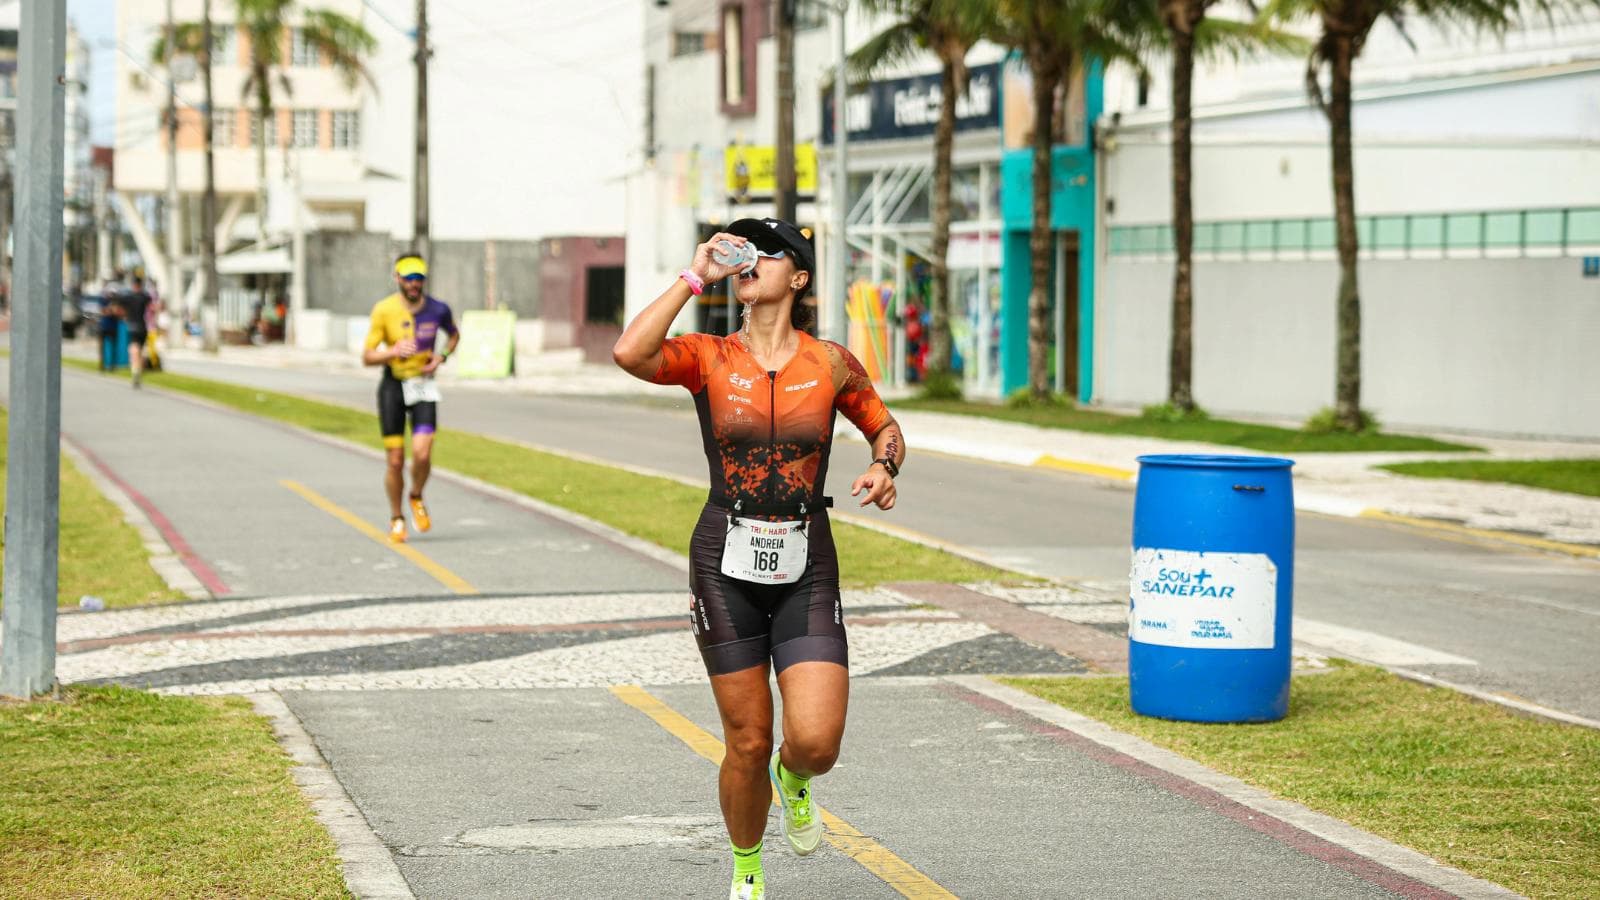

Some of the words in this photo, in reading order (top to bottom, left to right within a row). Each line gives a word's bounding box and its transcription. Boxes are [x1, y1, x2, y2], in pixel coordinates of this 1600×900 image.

[750, 525, 762, 535] TRI
[768, 527, 788, 535] HARD
[750, 536, 785, 549] ANDREIA
[753, 550, 779, 572] 168
[1141, 580, 1236, 599] SANEPAR
